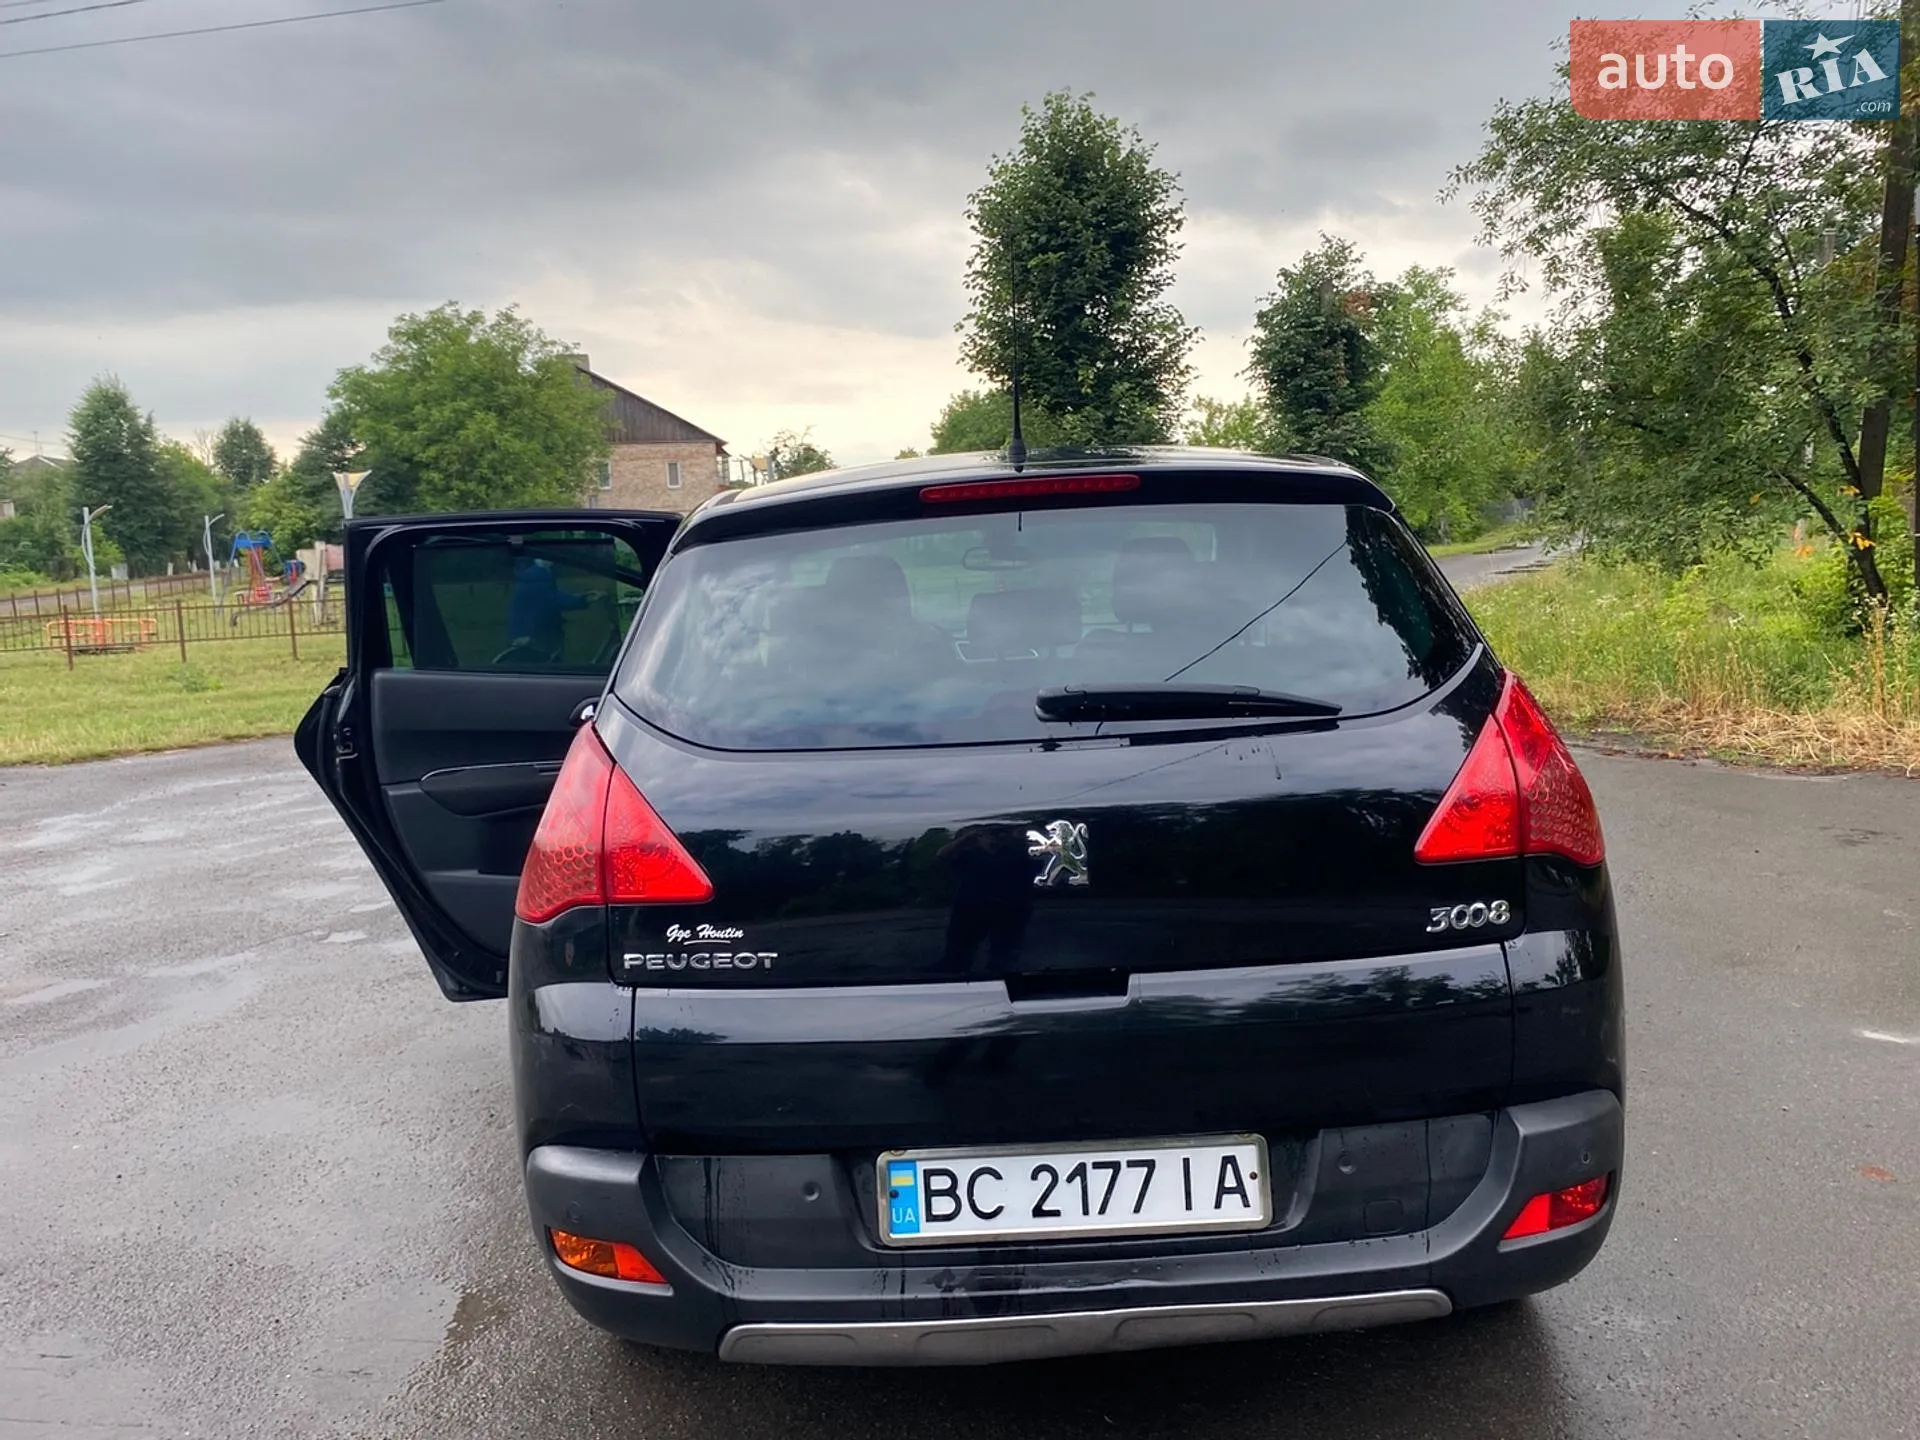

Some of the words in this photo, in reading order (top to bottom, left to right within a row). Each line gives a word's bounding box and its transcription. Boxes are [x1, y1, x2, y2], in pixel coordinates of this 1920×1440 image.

[1426, 899, 1511, 933] 3008
[623, 952, 778, 970] PEUGEOT
[922, 1166, 1005, 1222] BC
[1030, 1158, 1157, 1218] 2177
[892, 1206, 916, 1224] UA
